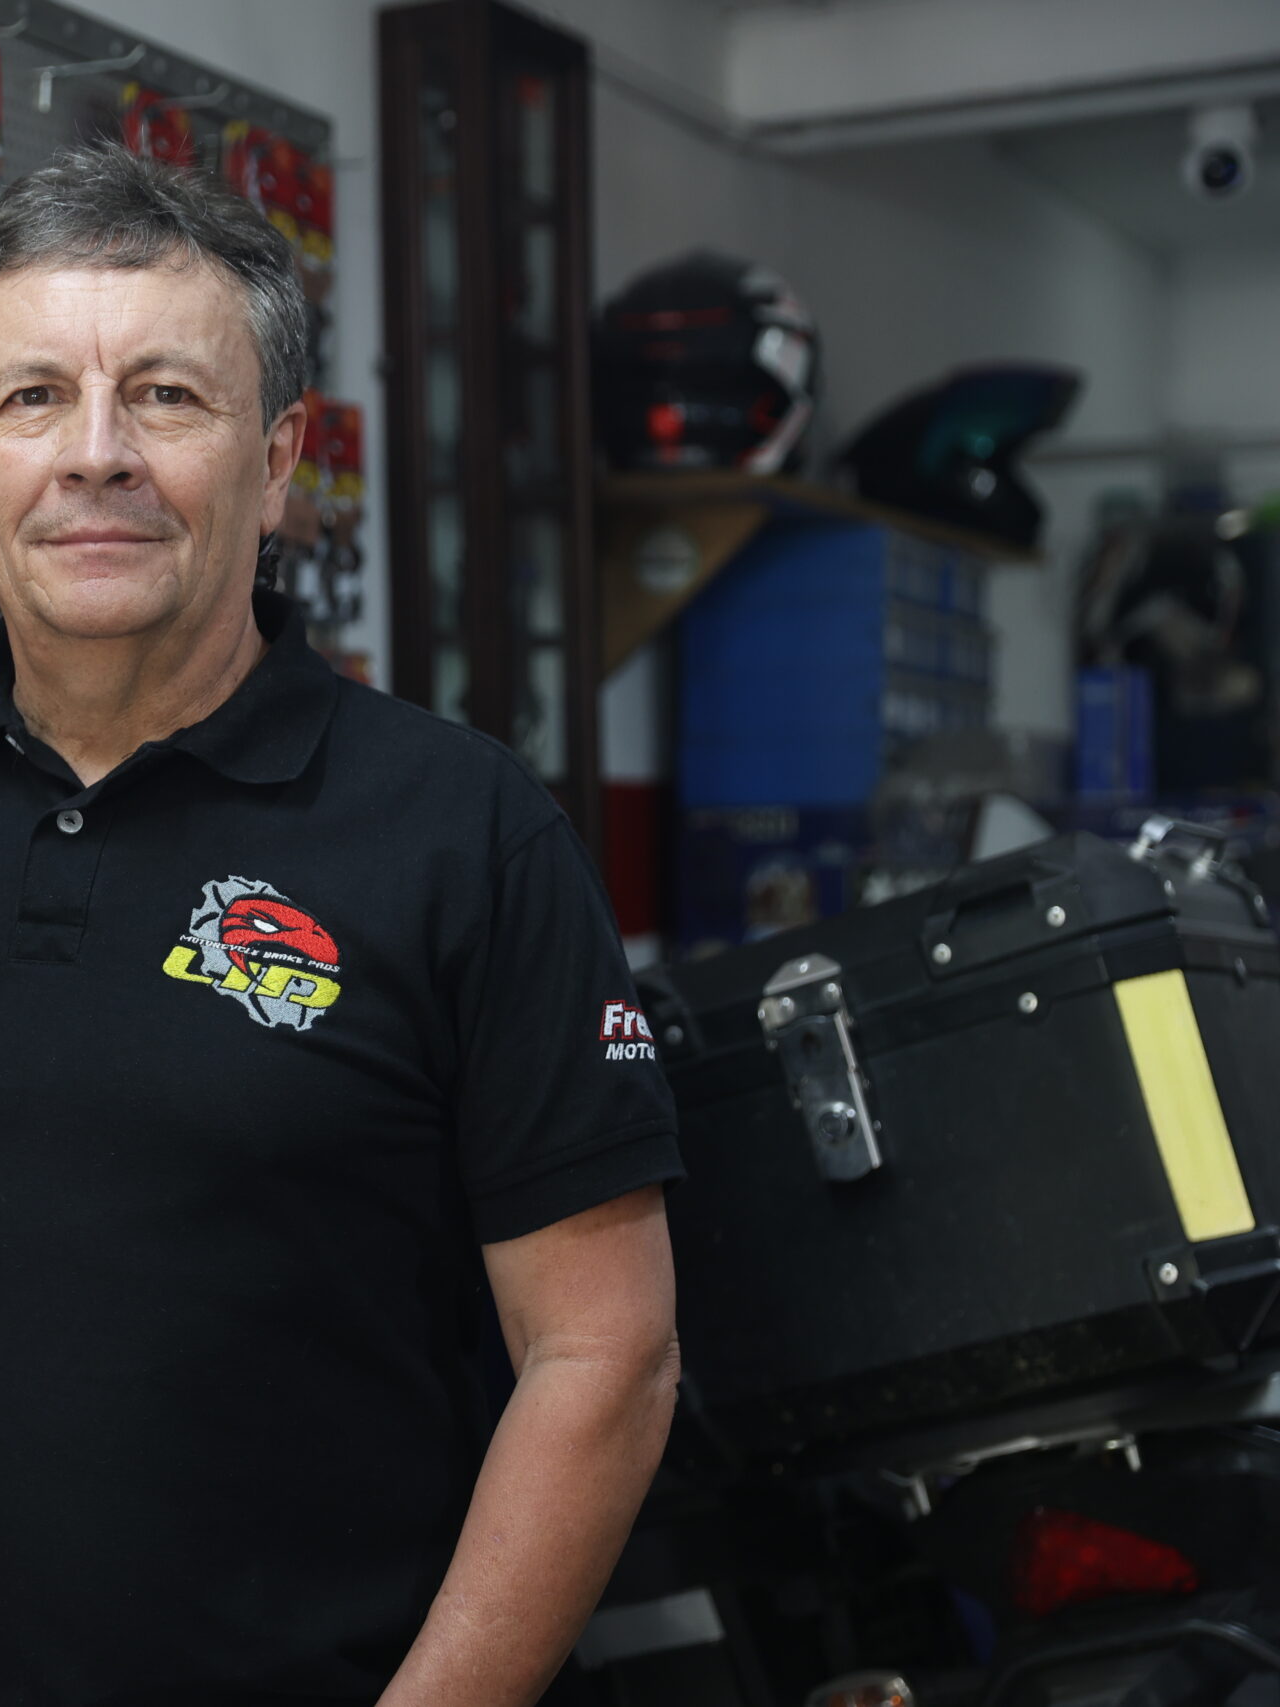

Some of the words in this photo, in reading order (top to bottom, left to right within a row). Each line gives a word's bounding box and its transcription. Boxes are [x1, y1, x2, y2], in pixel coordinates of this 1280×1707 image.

[162, 946, 341, 1009] LID
[180, 934, 260, 956] MOTORCYCLE
[263, 951, 304, 964] BRAKE
[308, 960, 342, 973] PADS
